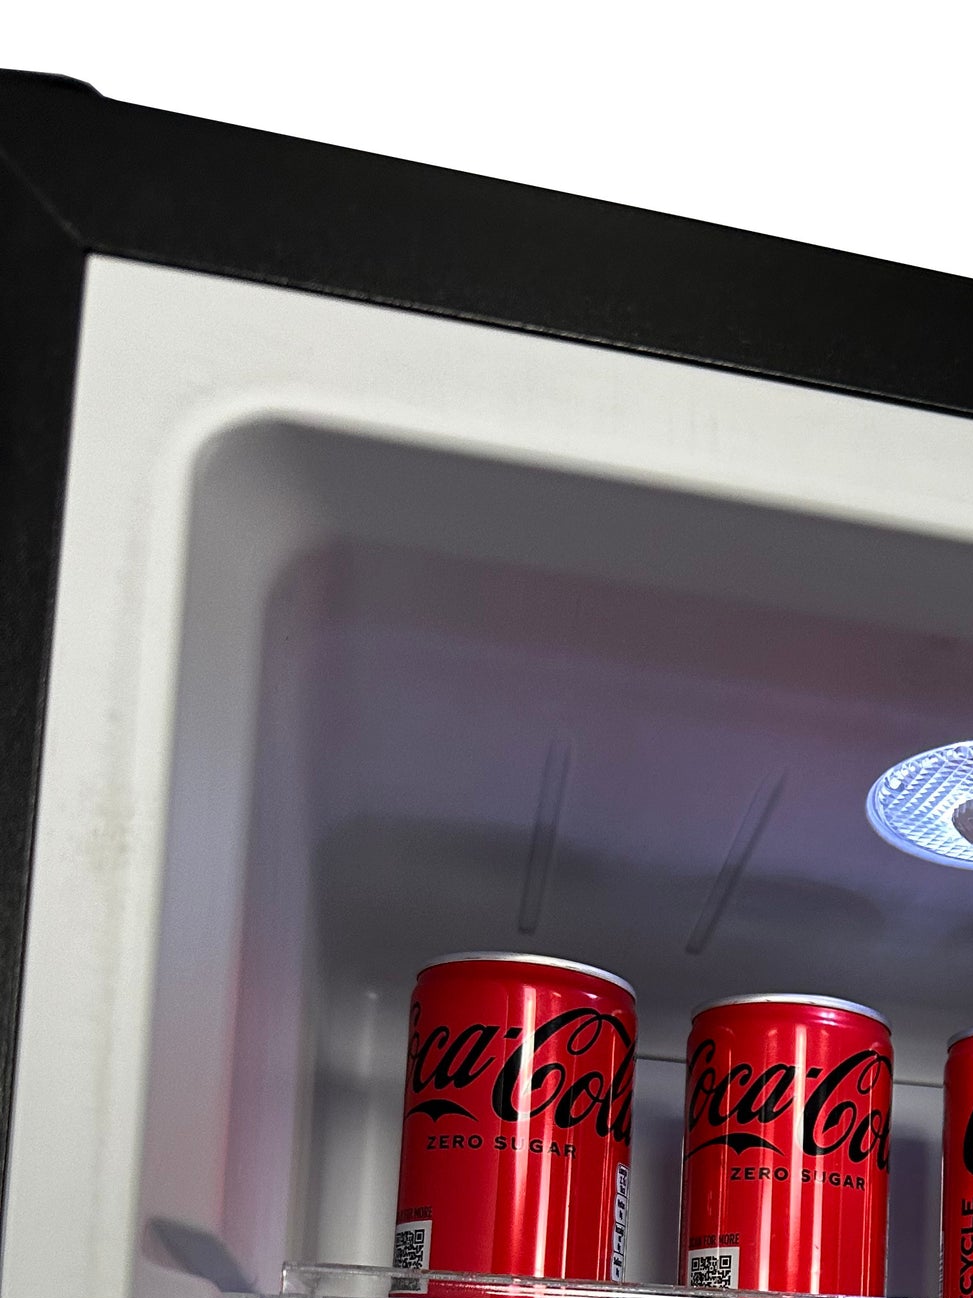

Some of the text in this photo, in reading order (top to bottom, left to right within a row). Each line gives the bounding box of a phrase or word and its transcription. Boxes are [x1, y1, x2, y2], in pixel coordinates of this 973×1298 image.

[426, 1134, 577, 1160] ZERO SUGAR
[730, 1166, 866, 1190] ZERO SUGAR
